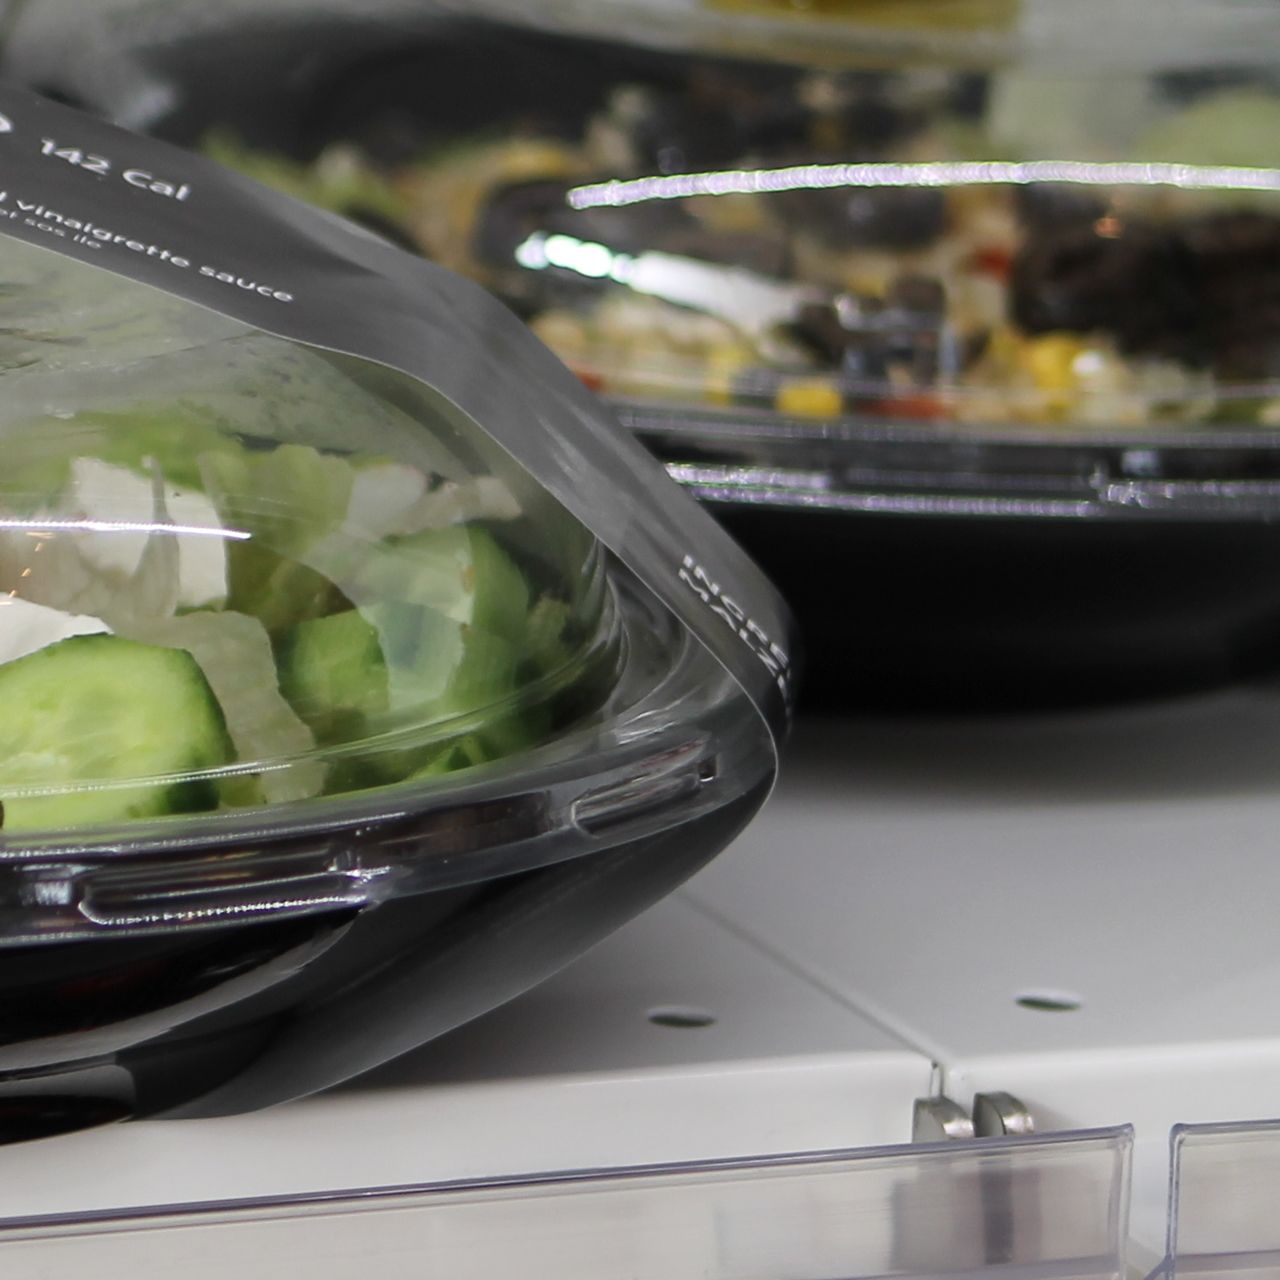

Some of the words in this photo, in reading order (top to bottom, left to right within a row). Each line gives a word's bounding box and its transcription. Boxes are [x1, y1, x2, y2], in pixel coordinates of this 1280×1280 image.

[41, 137, 111, 176] 142
[122, 168, 191, 202] Cal
[16, 199, 190, 268] vinaigrette
[199, 266, 293, 303] sauce
[24, 218, 66, 238] sos
